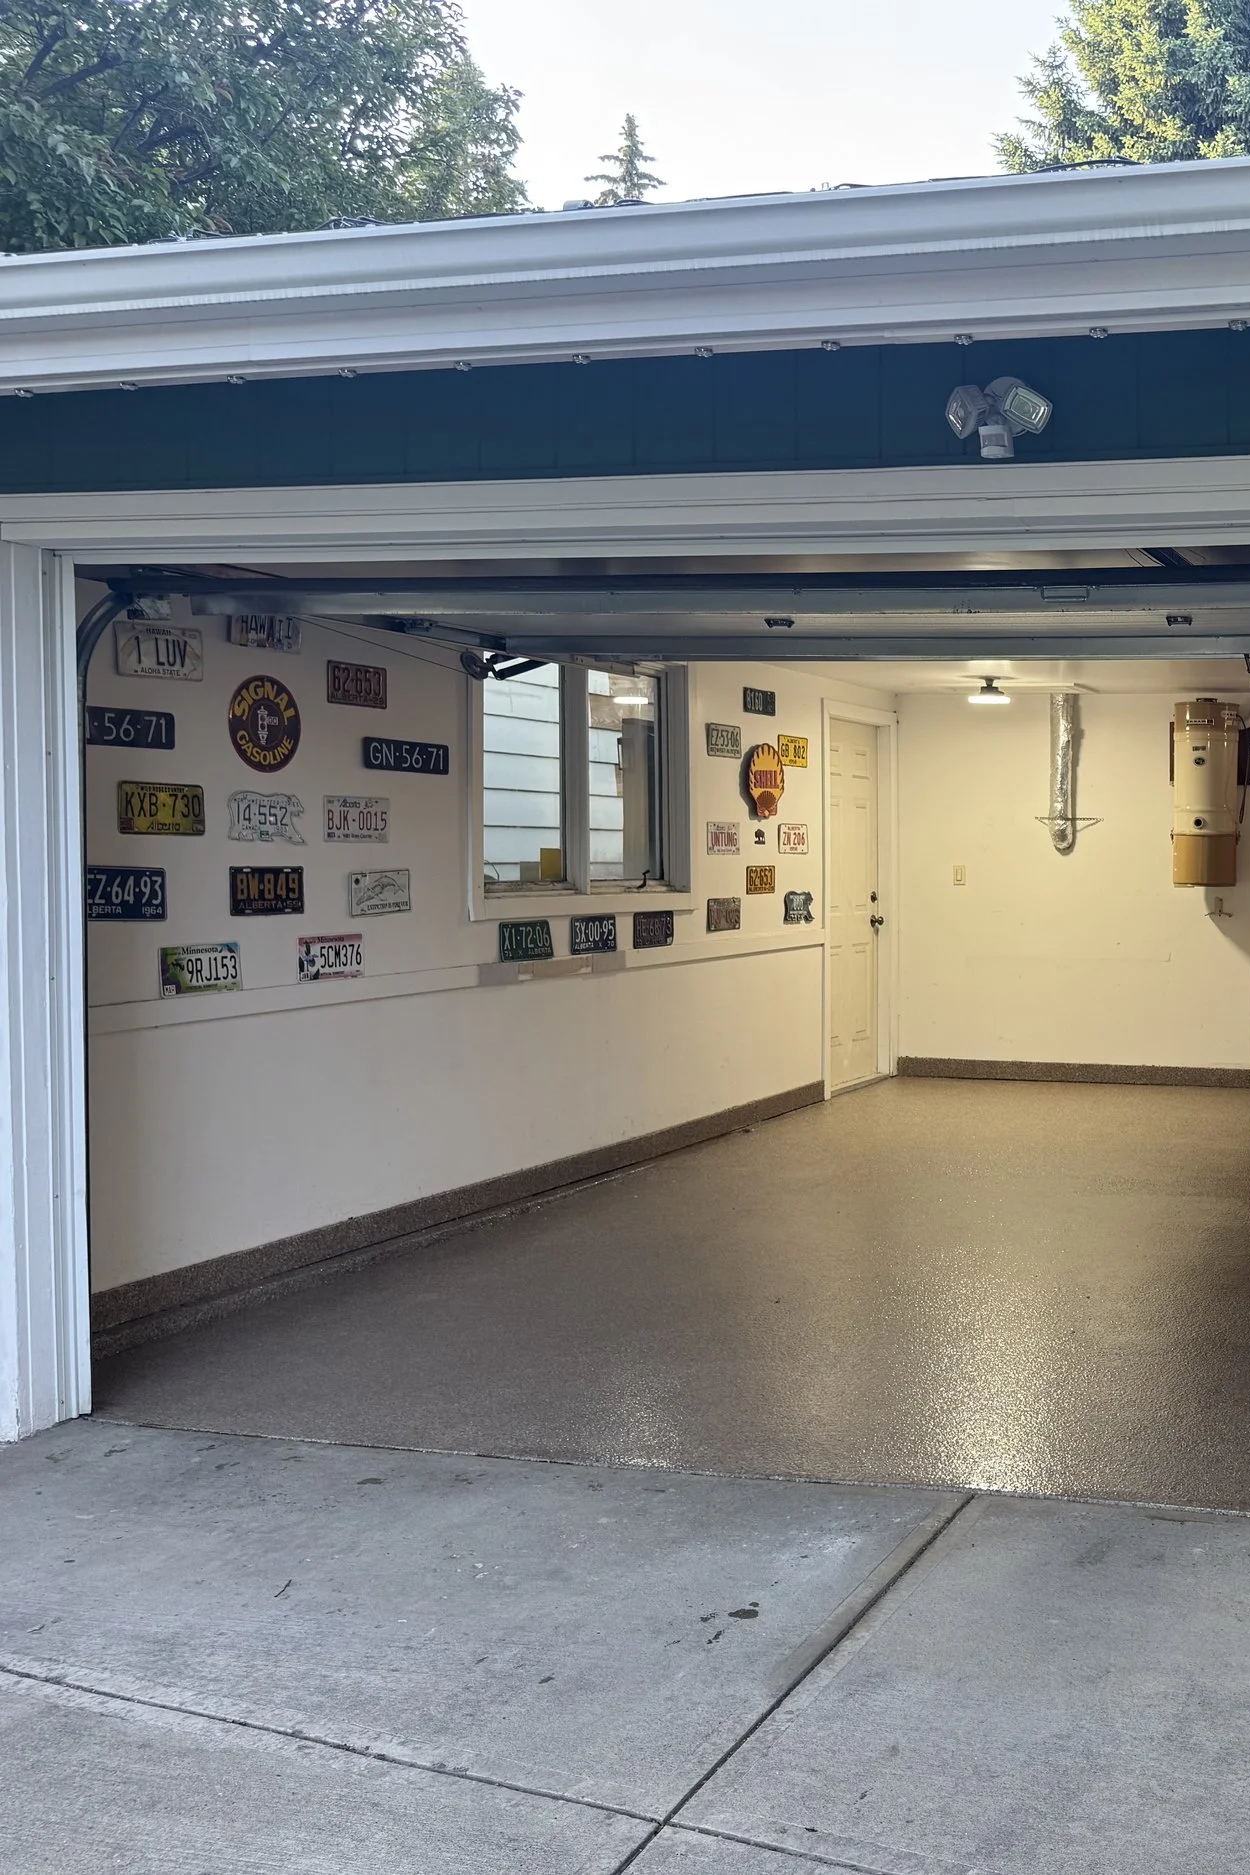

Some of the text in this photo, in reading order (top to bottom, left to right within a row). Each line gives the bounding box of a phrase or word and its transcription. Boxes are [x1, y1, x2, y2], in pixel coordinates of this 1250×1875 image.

[145, 627, 172, 636] HAWAII
[155, 636, 188, 668] LUV
[140, 666, 181, 677] ALOHA STATE
[233, 681, 296, 725] SIGNAL
[236, 730, 294, 765] GASOLINE
[754, 769, 780, 789] SHELL
[340, 798, 361, 809] Alberta
[710, 831, 738, 847] UNTUNG
[141, 906, 163, 915] 1964
[239, 901, 283, 909] ALBERTA
[316, 935, 345, 944] Minnesota
[181, 946, 219, 956] Minnesota
[320, 944, 362, 969] 5CM376
[186, 955, 238, 983] 9RJ153
